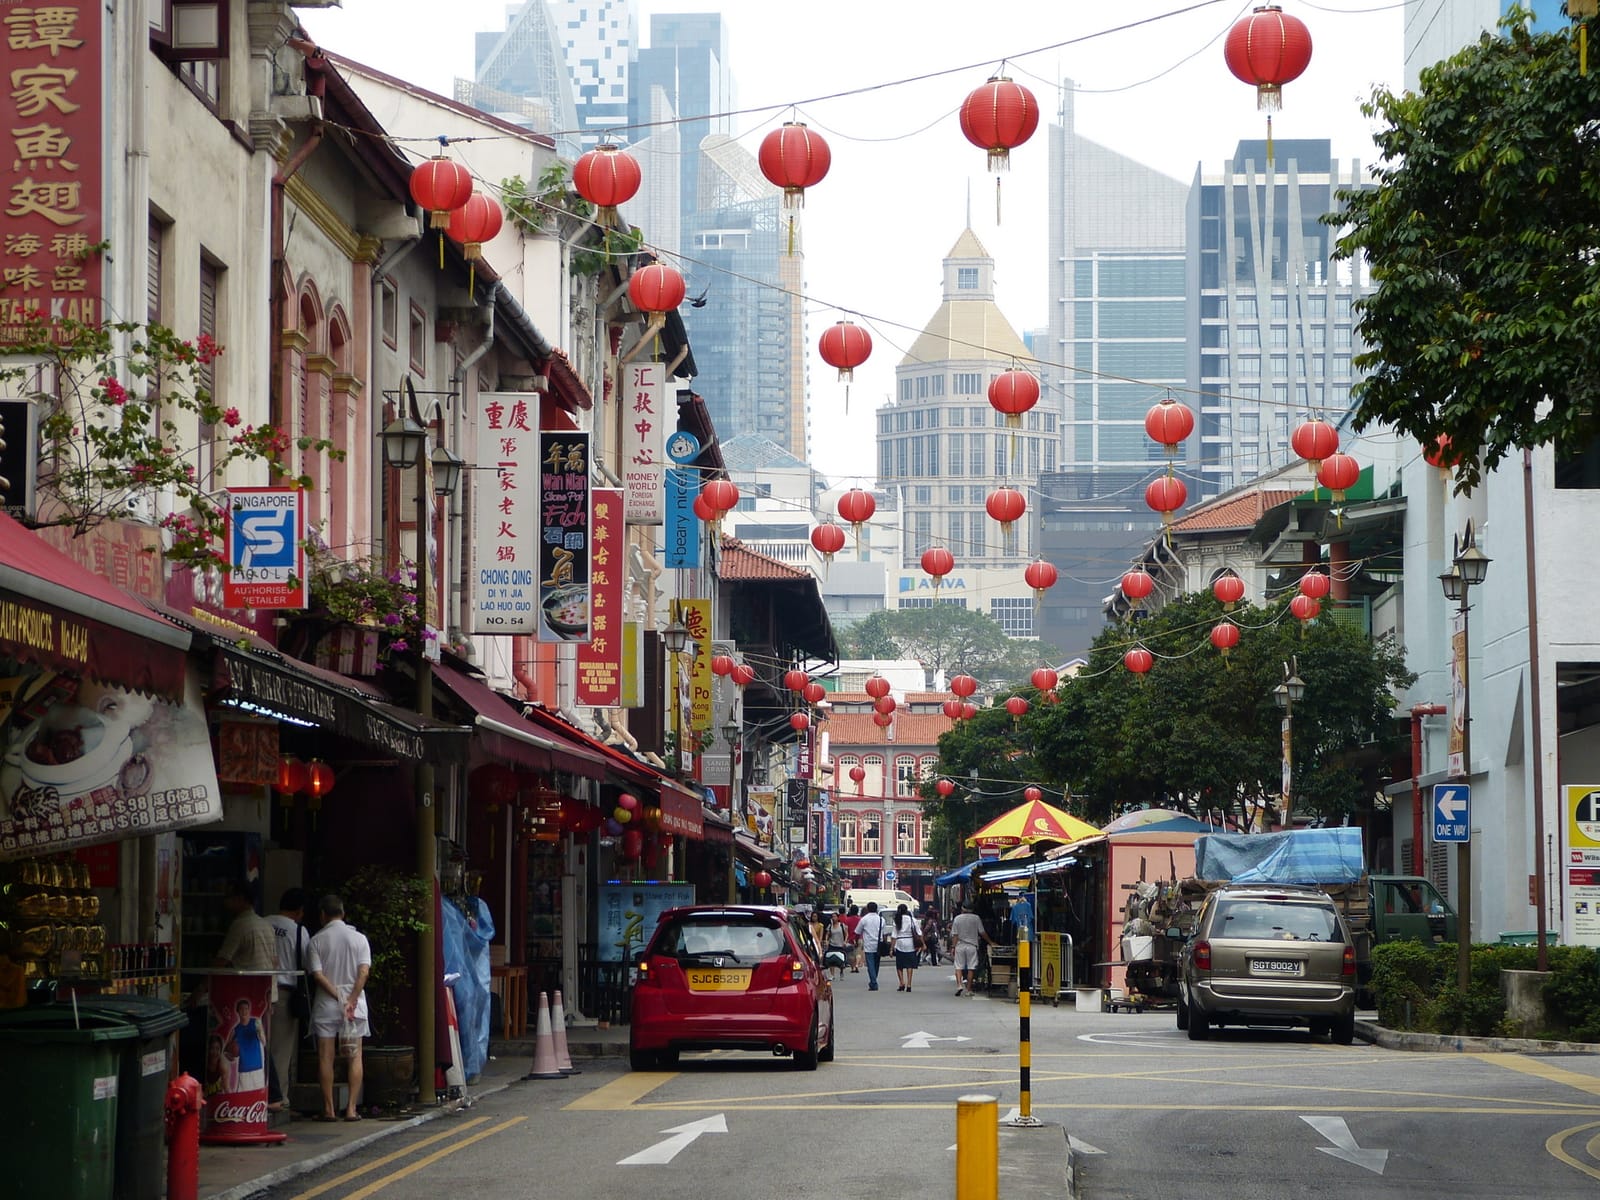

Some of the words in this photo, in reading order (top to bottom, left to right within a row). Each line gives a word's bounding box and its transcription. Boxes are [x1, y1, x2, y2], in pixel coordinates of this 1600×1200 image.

[3, 6, 86, 226] 譚家魚翅
[484, 399, 532, 432] 重慶
[632, 367, 656, 466] 汇款中心
[543, 473, 564, 491] Wan
[626, 473, 659, 481] MONEY
[628, 482, 658, 490] WORLD
[233, 496, 295, 507] SINGAPORE
[567, 491, 585, 502] Pot
[543, 501, 586, 527] Fish
[673, 514, 690, 556] beary
[480, 569, 509, 585] CHONG
[511, 569, 532, 585] QING
[591, 503, 610, 654] 雙華古玩玉器行
[234, 586, 295, 595] AUTHORISED
[488, 588, 496, 598] DI
[499, 588, 508, 598] YI
[510, 588, 523, 598] JIA
[480, 601, 495, 611] LAO
[497, 601, 513, 611] HUO
[515, 601, 531, 611] GUO
[486, 617, 508, 625] NO.
[510, 617, 524, 625] 54
[694, 687, 710, 700] Po
[423, 792, 431, 808] 6
[1437, 824, 1452, 836] ONE
[1453, 824, 1467, 836] WAY
[1253, 961, 1299, 970] SGT9002Y
[692, 975, 747, 984] SJC6529T
